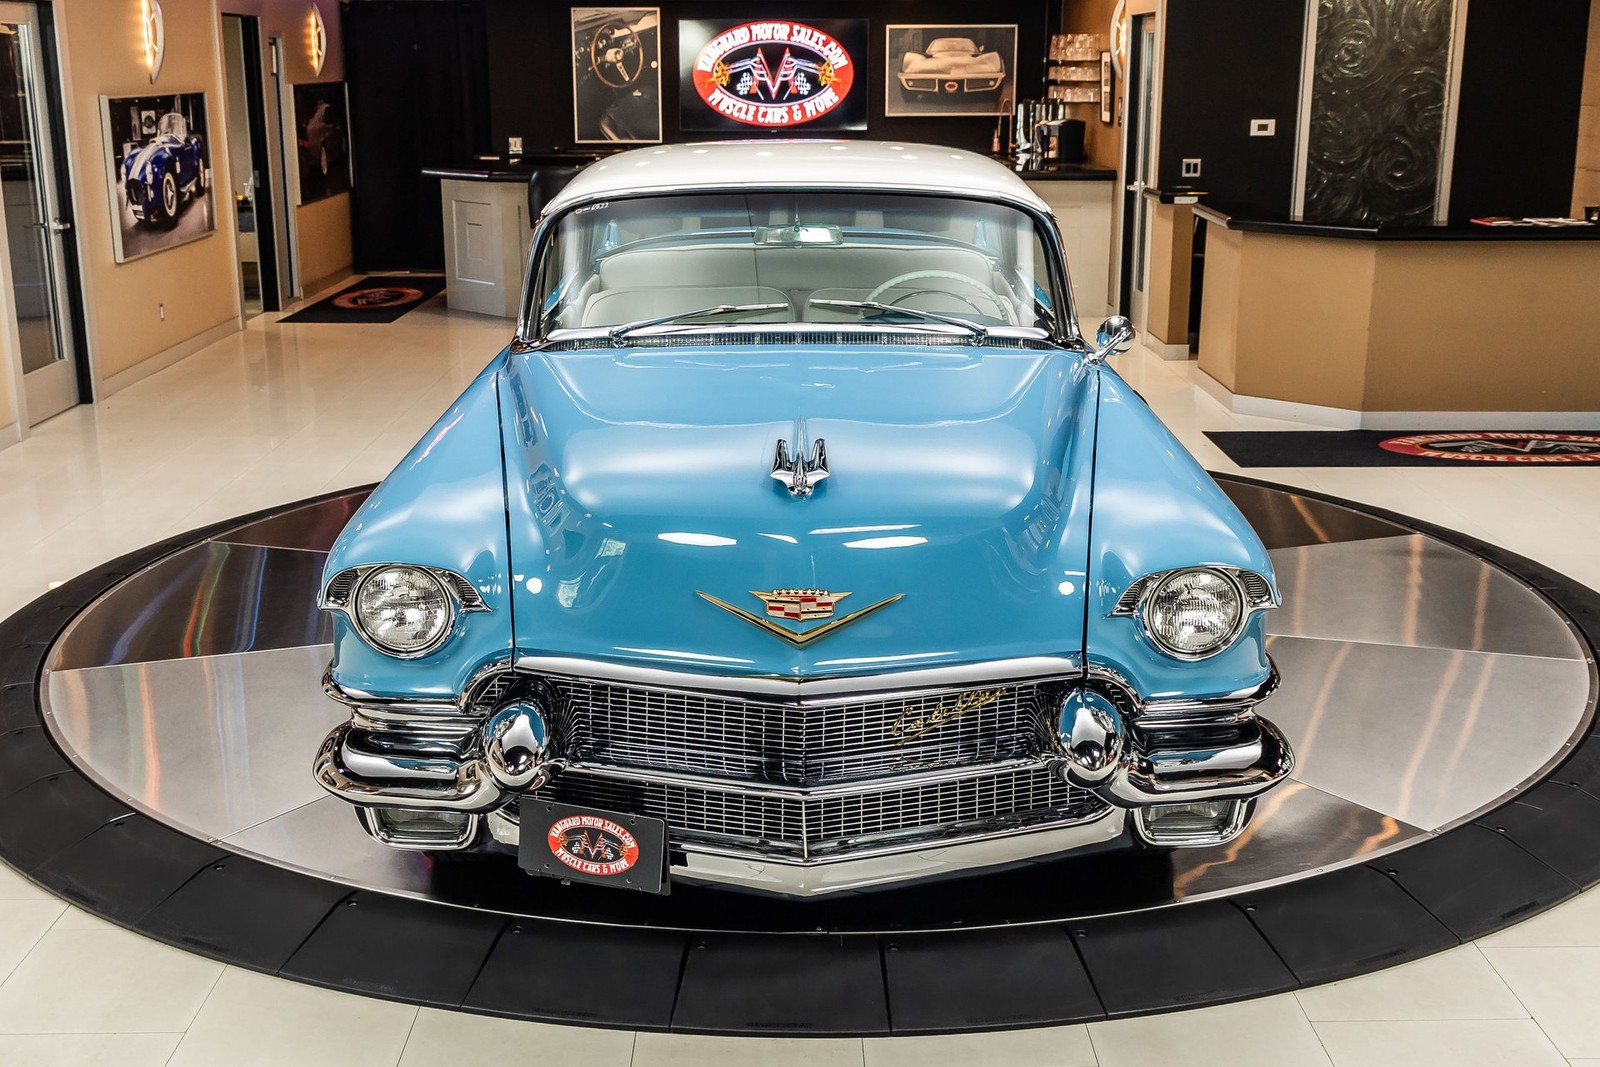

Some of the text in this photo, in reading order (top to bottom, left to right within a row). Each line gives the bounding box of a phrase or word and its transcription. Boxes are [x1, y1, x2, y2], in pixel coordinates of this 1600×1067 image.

[750, 23, 790, 42] MOTOR
[707, 88, 756, 122] MUSCLE
[757, 106, 789, 124] CARS
[792, 105, 803, 121] &
[550, 816, 636, 849] VANGUARD MOTOR SALES.COM
[555, 849, 630, 874] MUSCLE CARS & MORE
